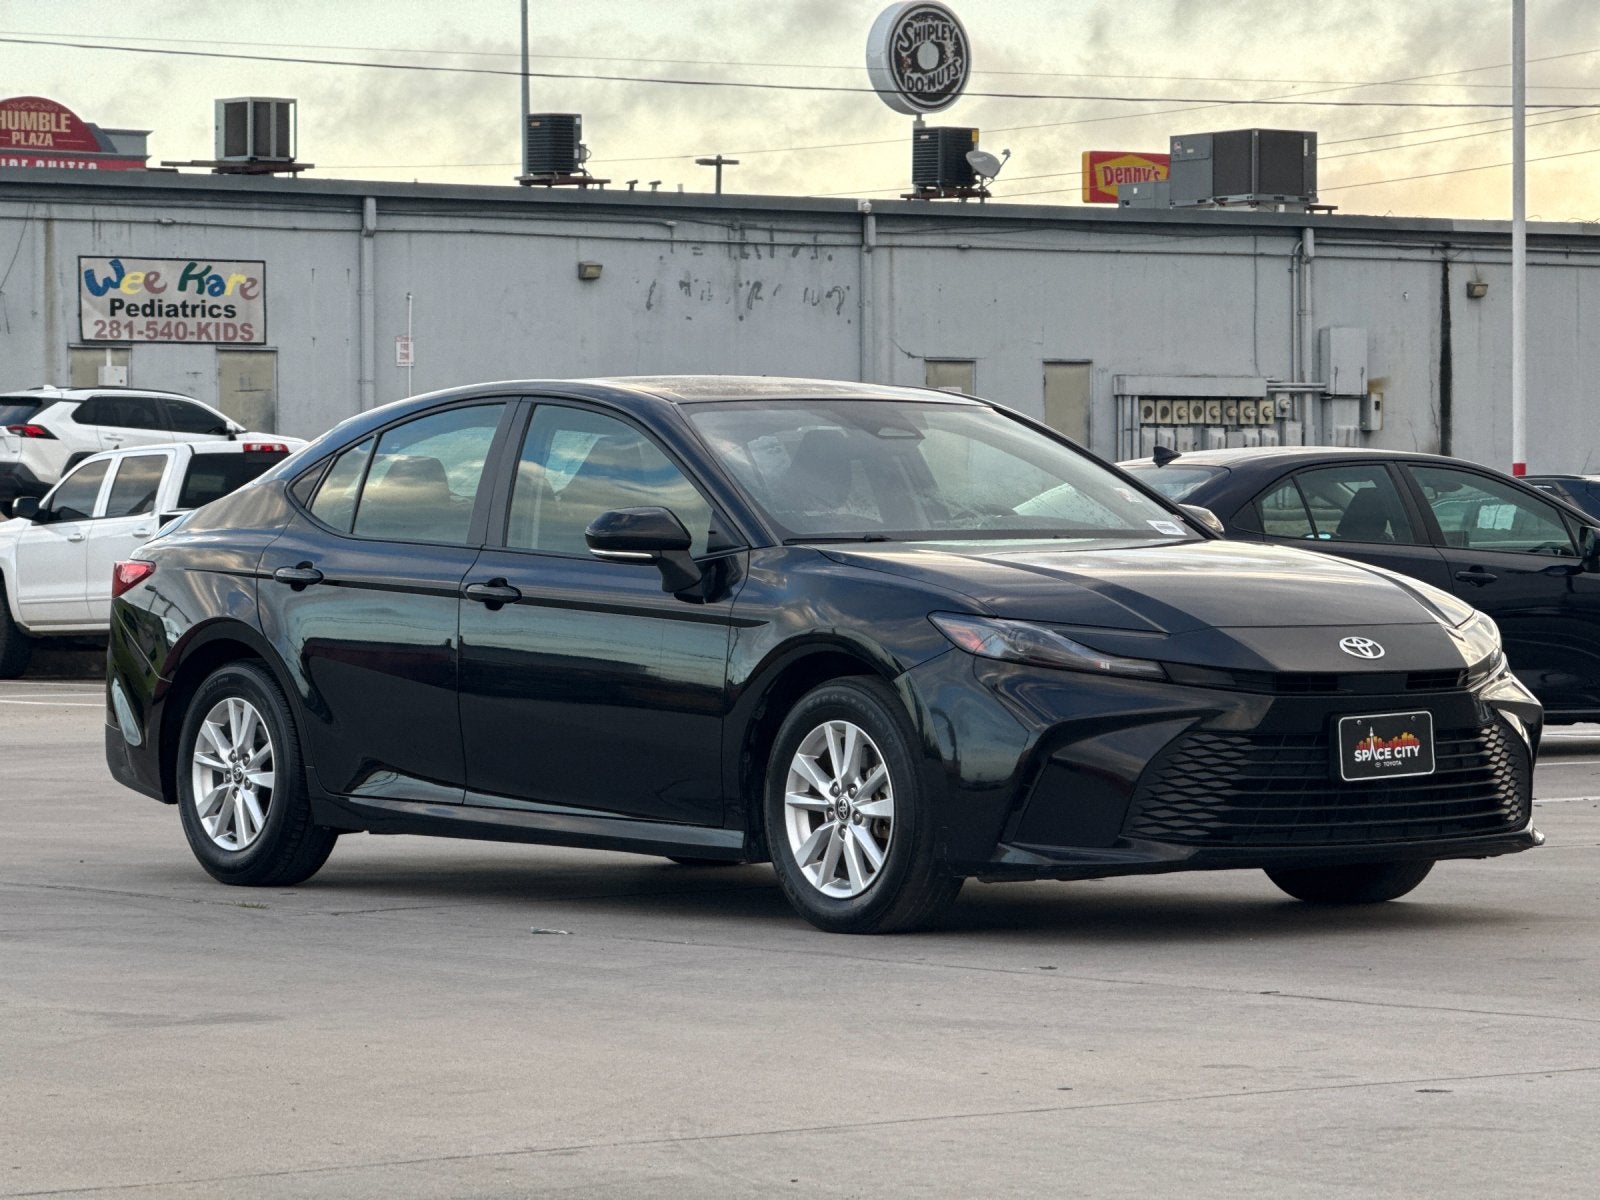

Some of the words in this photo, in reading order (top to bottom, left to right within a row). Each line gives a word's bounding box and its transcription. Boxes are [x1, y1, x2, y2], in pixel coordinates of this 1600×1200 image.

[899, 20, 956, 52] SHIPLEY
[0, 110, 71, 133] HUMBLE
[11, 131, 54, 147] PLAZA
[1102, 165, 1161, 187] Denny's
[84, 258, 167, 297] Wee
[177, 261, 260, 300] Kare
[109, 298, 237, 318] Pediatrics
[93, 319, 254, 342] 281-540-KIDS
[1354, 746, 1391, 762] SPACE
[1394, 745, 1420, 758] CITY
